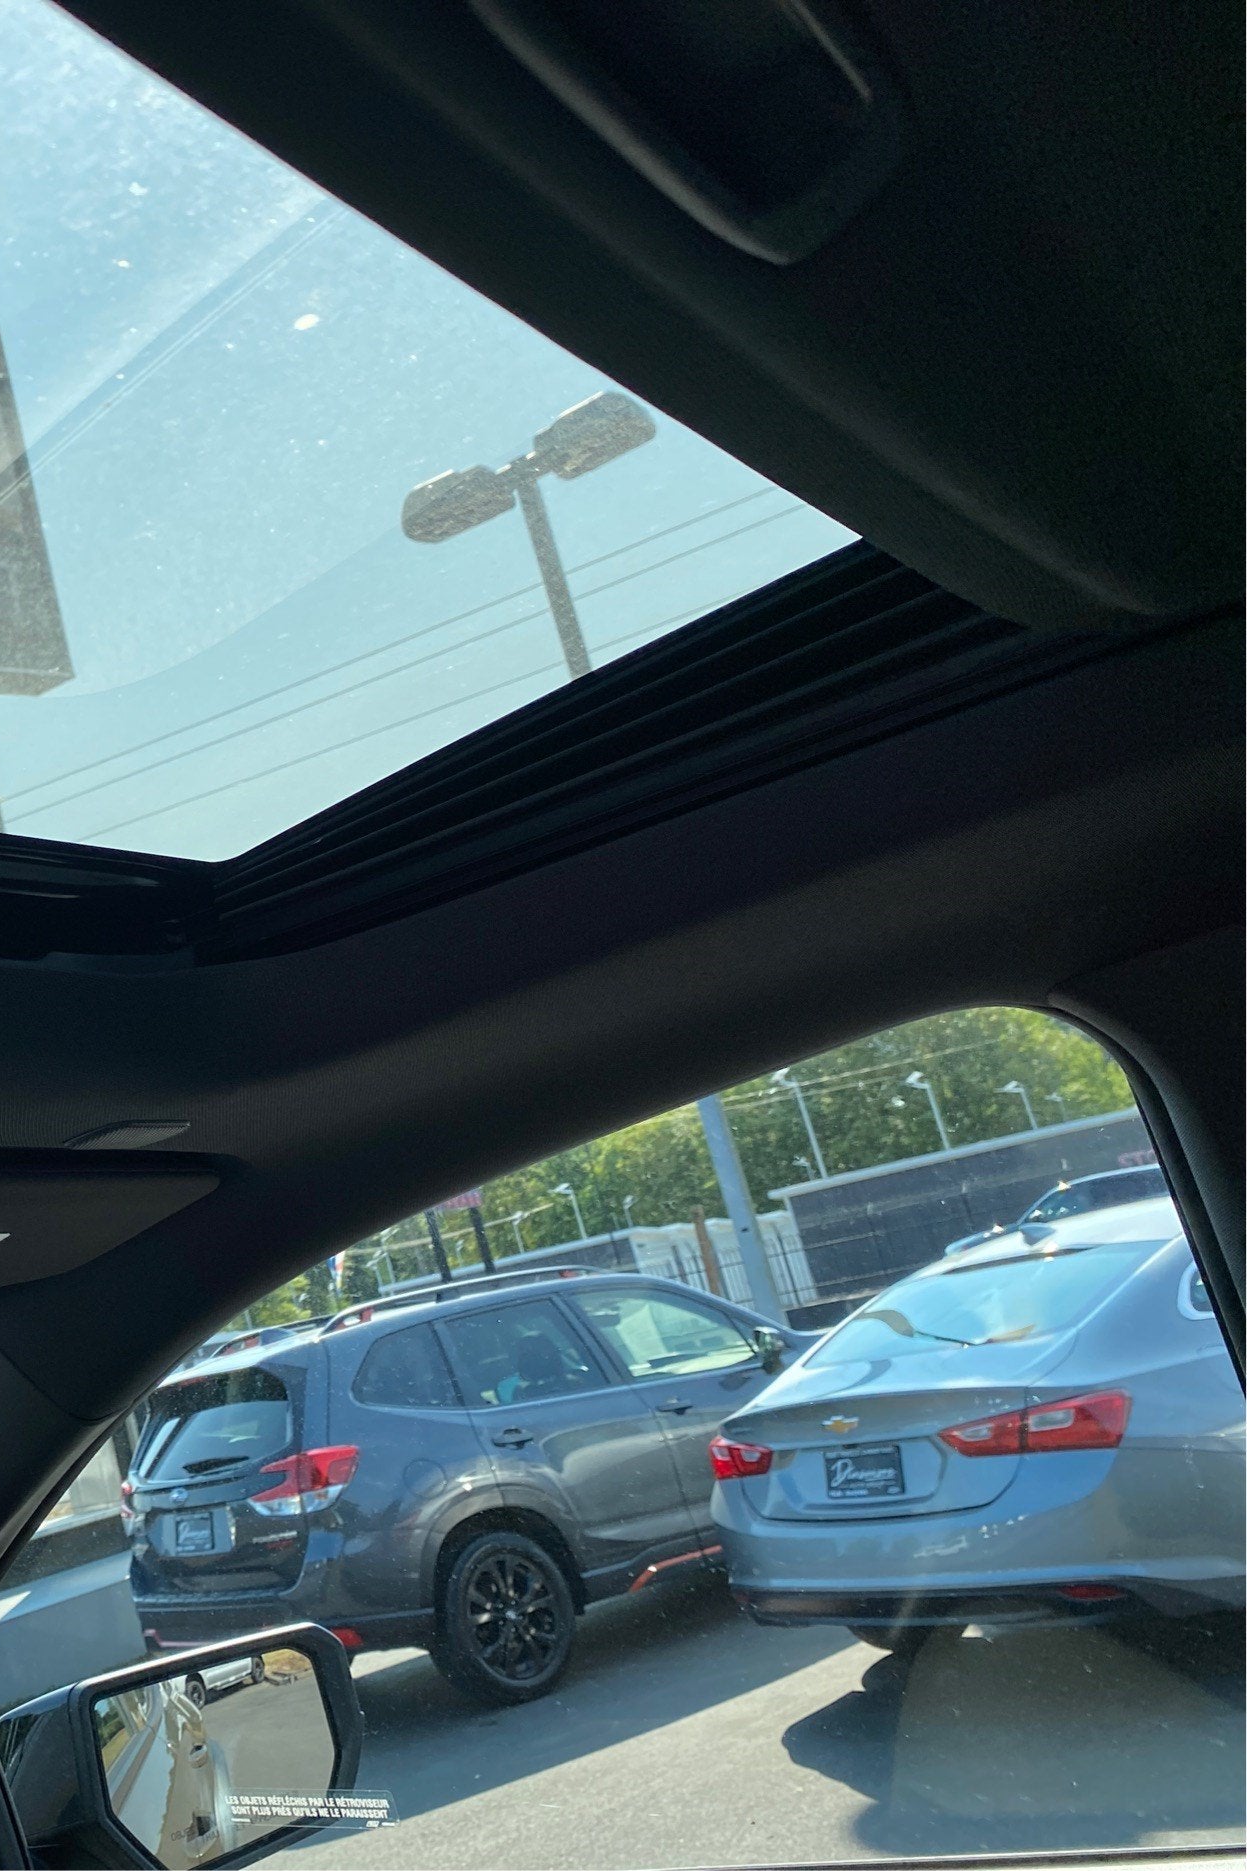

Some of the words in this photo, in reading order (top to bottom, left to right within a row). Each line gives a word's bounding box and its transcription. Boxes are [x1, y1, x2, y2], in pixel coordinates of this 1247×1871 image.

[225, 1795, 239, 1805] LES
[239, 1795, 267, 1806] OBJETS
[308, 1797, 324, 1807] PAR
[325, 1797, 335, 1807] LE
[335, 1796, 390, 1808] RÉTROVISEUR
[231, 1806, 251, 1815] SONT
[251, 1806, 272, 1816] PLUS
[318, 1808, 330, 1817] NE
[330, 1808, 341, 1818] LE
[341, 1808, 388, 1819] PARAISSENT
